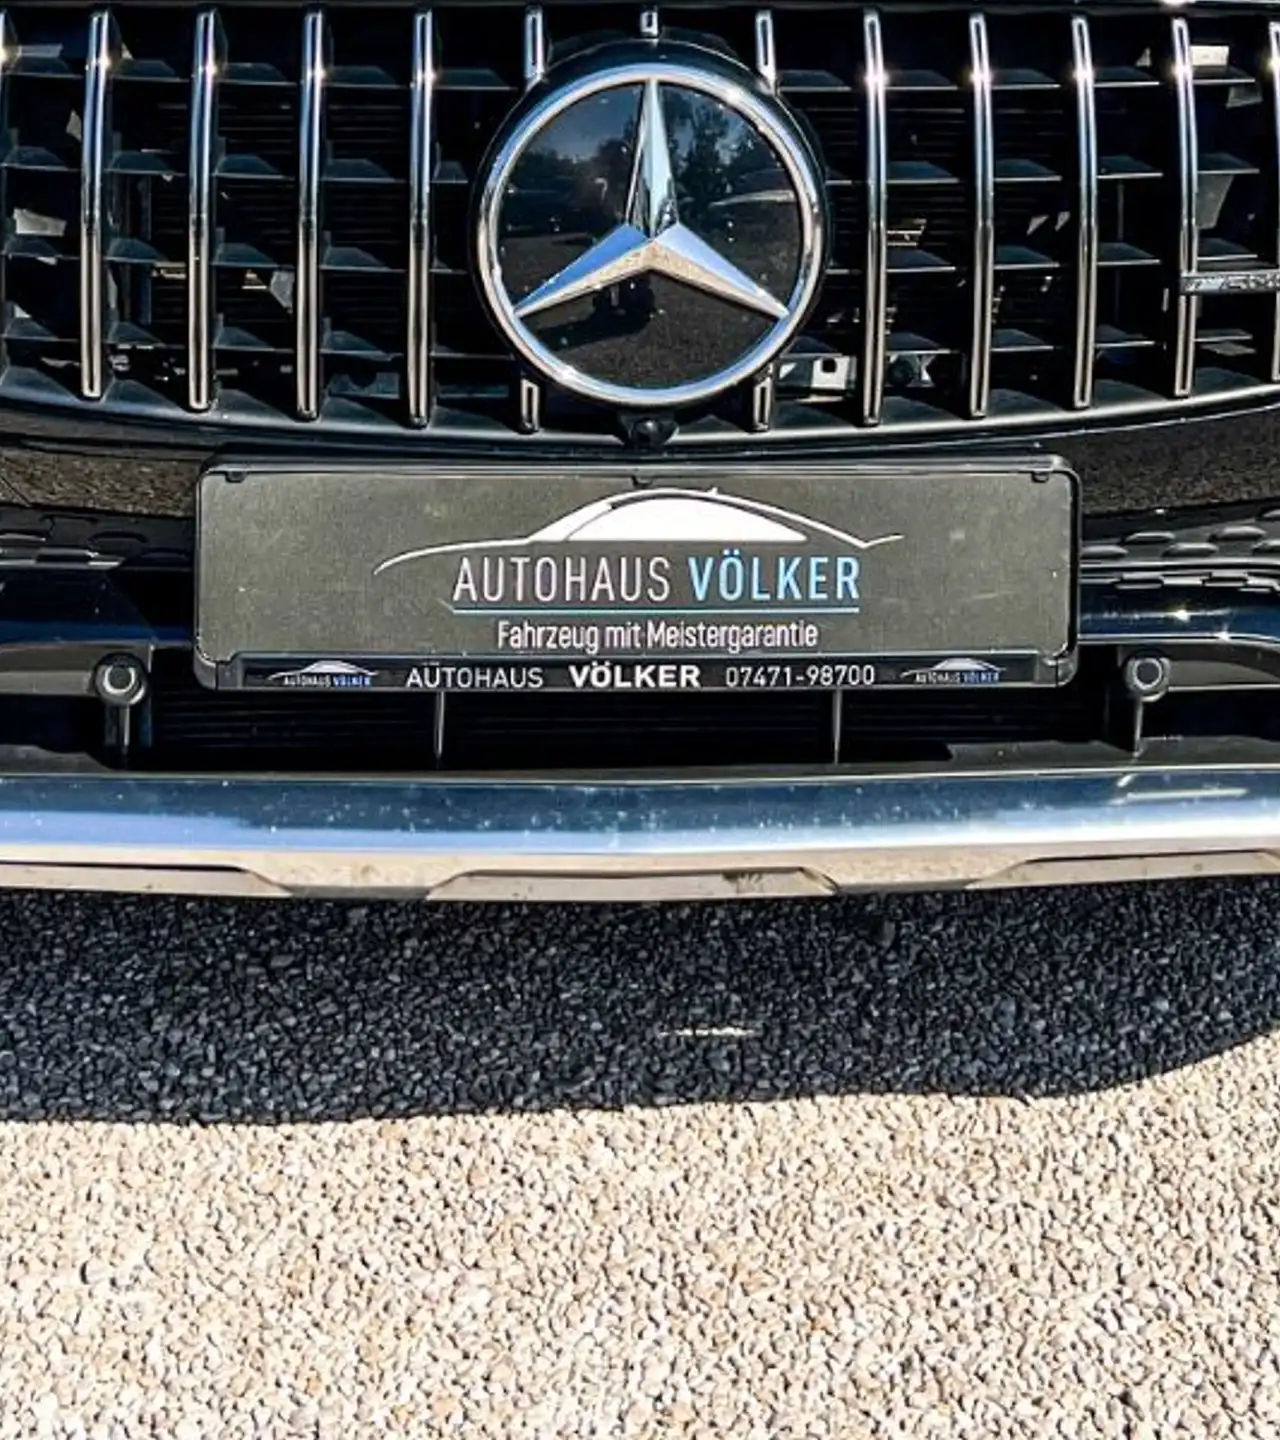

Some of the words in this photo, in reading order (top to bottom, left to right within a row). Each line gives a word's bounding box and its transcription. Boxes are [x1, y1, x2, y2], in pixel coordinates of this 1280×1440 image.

[453, 556, 671, 602] AUTOHAUS
[688, 548, 860, 602] VÖLKER
[498, 620, 598, 654] Fahrzeug
[605, 621, 642, 648] mit
[647, 619, 818, 654] Meistergarantie
[406, 666, 543, 688] AUTOHAUS
[568, 663, 701, 688] VÖLKER
[726, 664, 876, 687] 07471-98700
